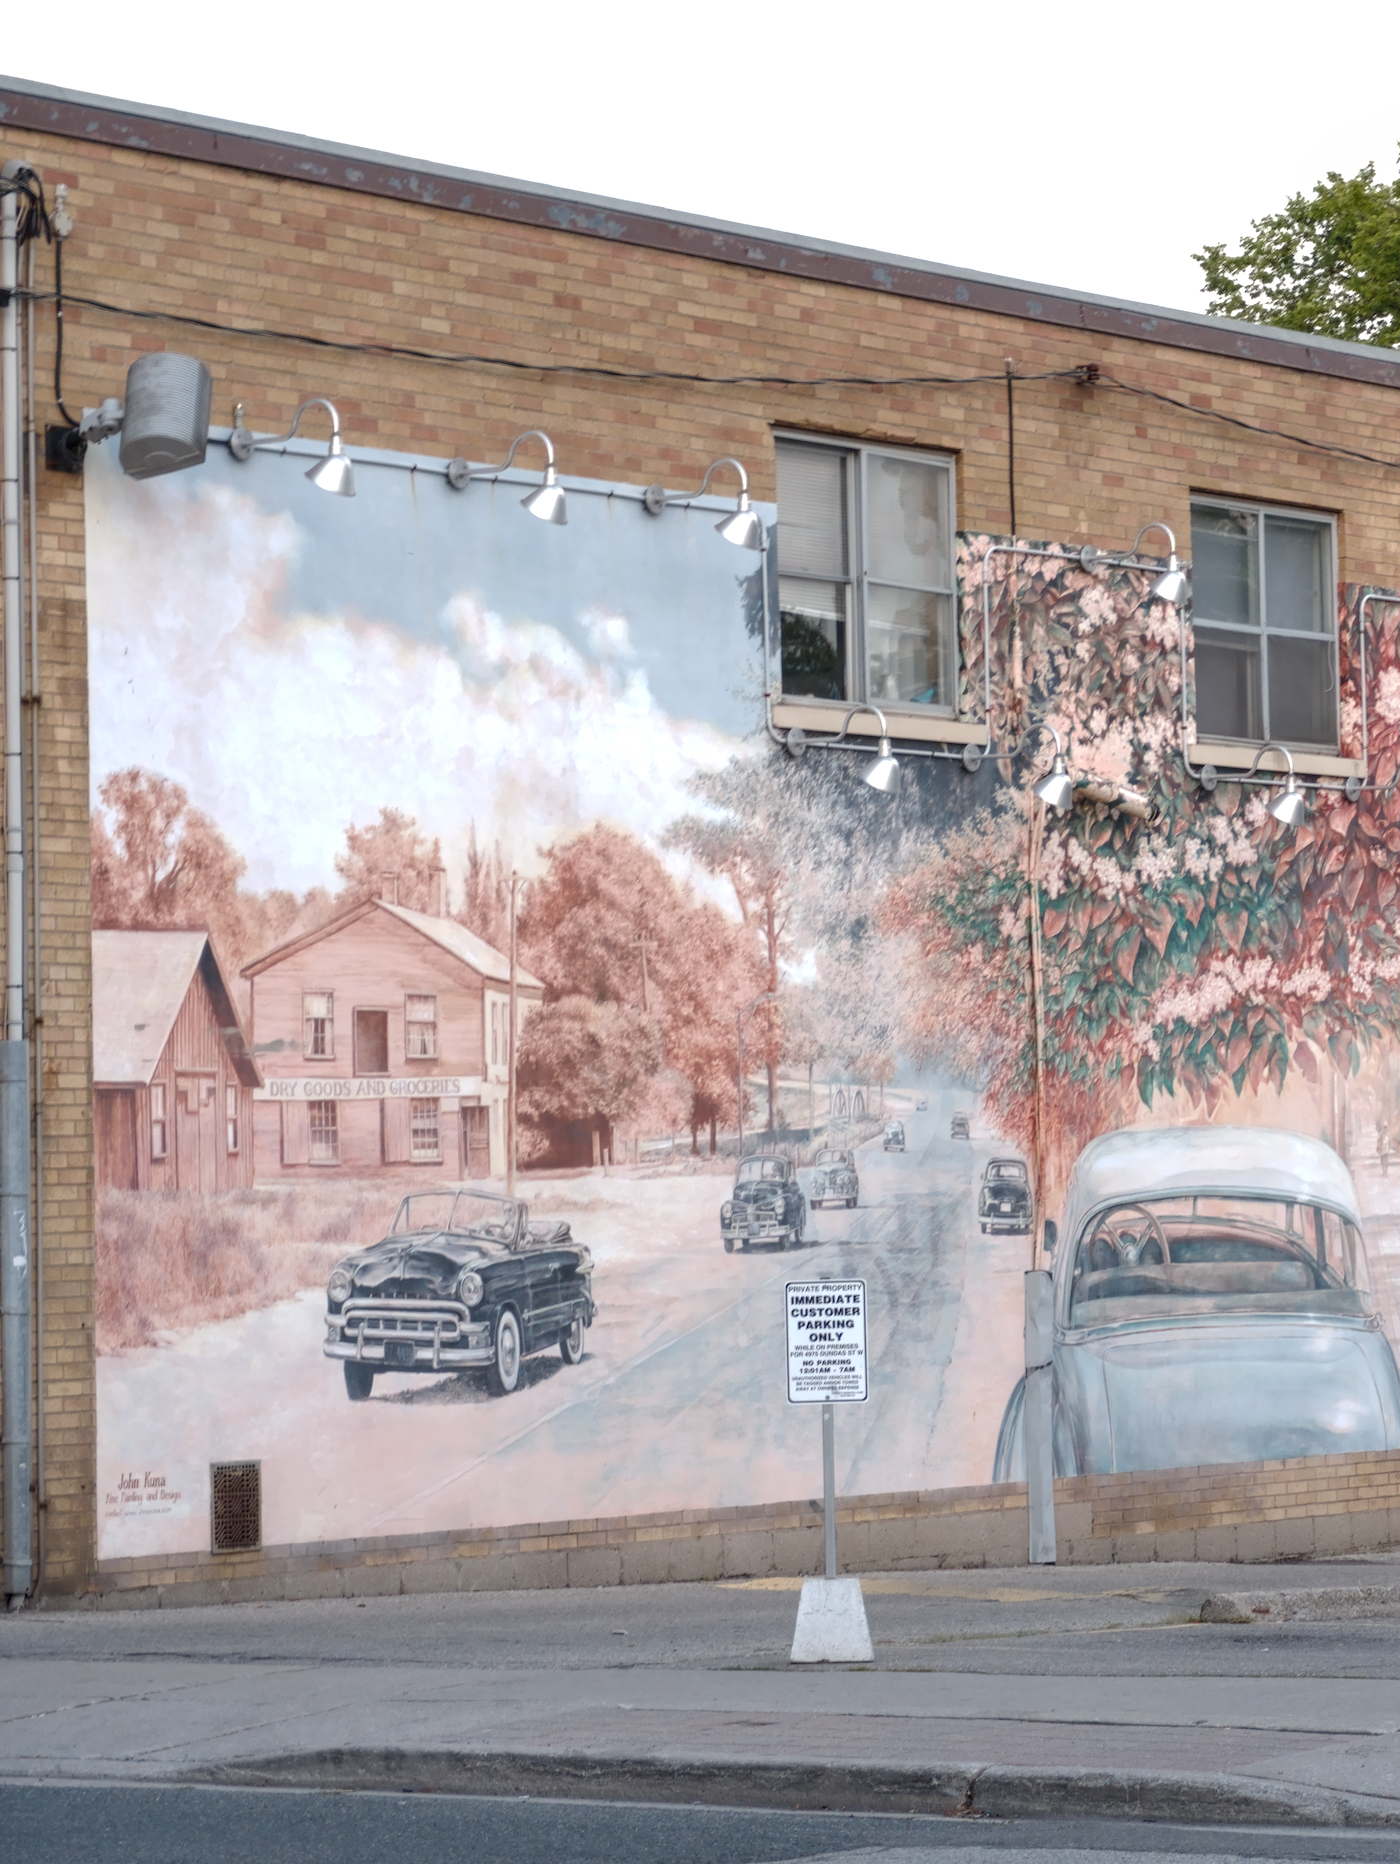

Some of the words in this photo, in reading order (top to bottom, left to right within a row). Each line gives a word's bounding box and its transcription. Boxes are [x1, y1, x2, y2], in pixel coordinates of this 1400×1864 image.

[270, 1081, 297, 1097] DRY
[303, 1081, 351, 1097] GOODS
[356, 1080, 386, 1095] AND
[389, 1078, 461, 1095] GROCERIES
[788, 1285, 820, 1293] PRIVATE
[822, 1284, 862, 1292] PROPERTY
[791, 1294, 860, 1305] IMMEDIATE
[791, 1307, 860, 1317] CUSTOMER
[797, 1320, 854, 1330] PARKING
[809, 1332, 844, 1342] ONLY
[118, 1472, 139, 1490] John
[144, 1471, 166, 1488] Kuna
[146, 1489, 158, 1501] and
[160, 1488, 181, 1504] Design
